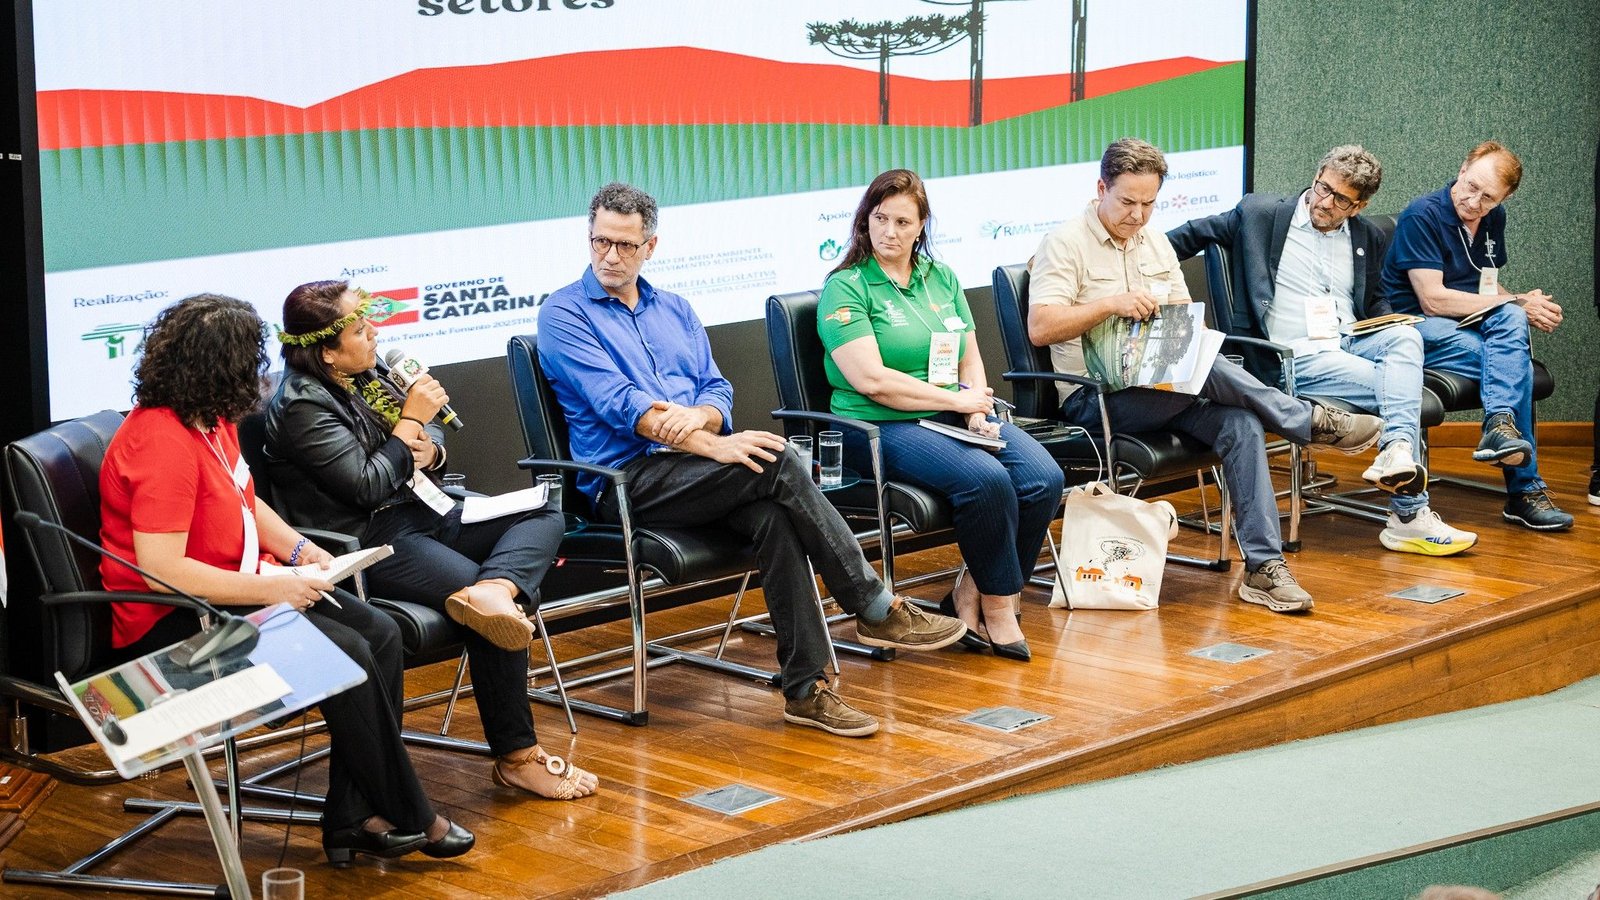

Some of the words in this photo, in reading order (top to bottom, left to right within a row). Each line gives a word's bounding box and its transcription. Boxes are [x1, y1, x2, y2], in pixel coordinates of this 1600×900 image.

[1003, 224, 1031, 237] RMA
[340, 265, 388, 278] Apoio:
[425, 278, 485, 291] GOVERNO
[74, 289, 169, 308] Realização:
[423, 284, 510, 306] SANTA
[402, 332, 434, 340] Termo
[449, 323, 492, 334] Fomento
[1425, 536, 1452, 545] FILA
